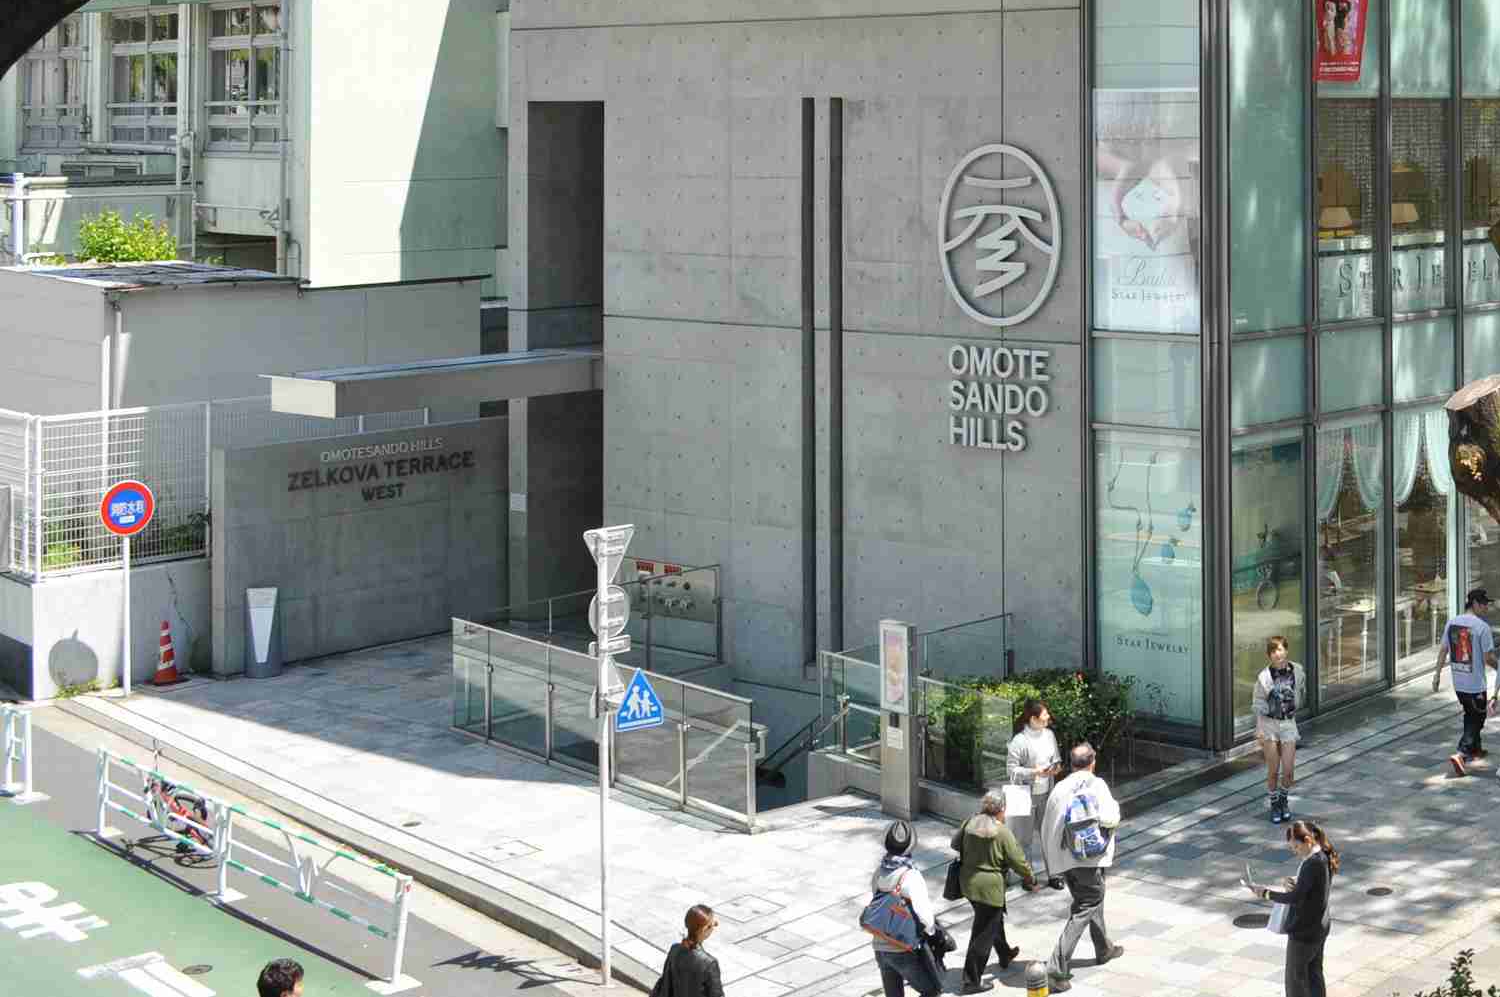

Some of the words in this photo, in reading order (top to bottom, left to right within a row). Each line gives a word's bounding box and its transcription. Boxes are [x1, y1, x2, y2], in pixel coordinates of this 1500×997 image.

[1338, 262, 1404, 298] STR
[948, 344, 1050, 381] OMOTE
[949, 380, 1049, 417] SANDO
[320, 442, 408, 462] OMOTESANDO
[410, 437, 444, 452] HILLS
[949, 415, 1026, 452] HILLS
[287, 462, 379, 492] ZELKOVA
[384, 451, 476, 478] TERRACE
[361, 483, 406, 501] WEST
[1114, 635, 1142, 648] STAR
[1144, 637, 1191, 654] JEWELRY
